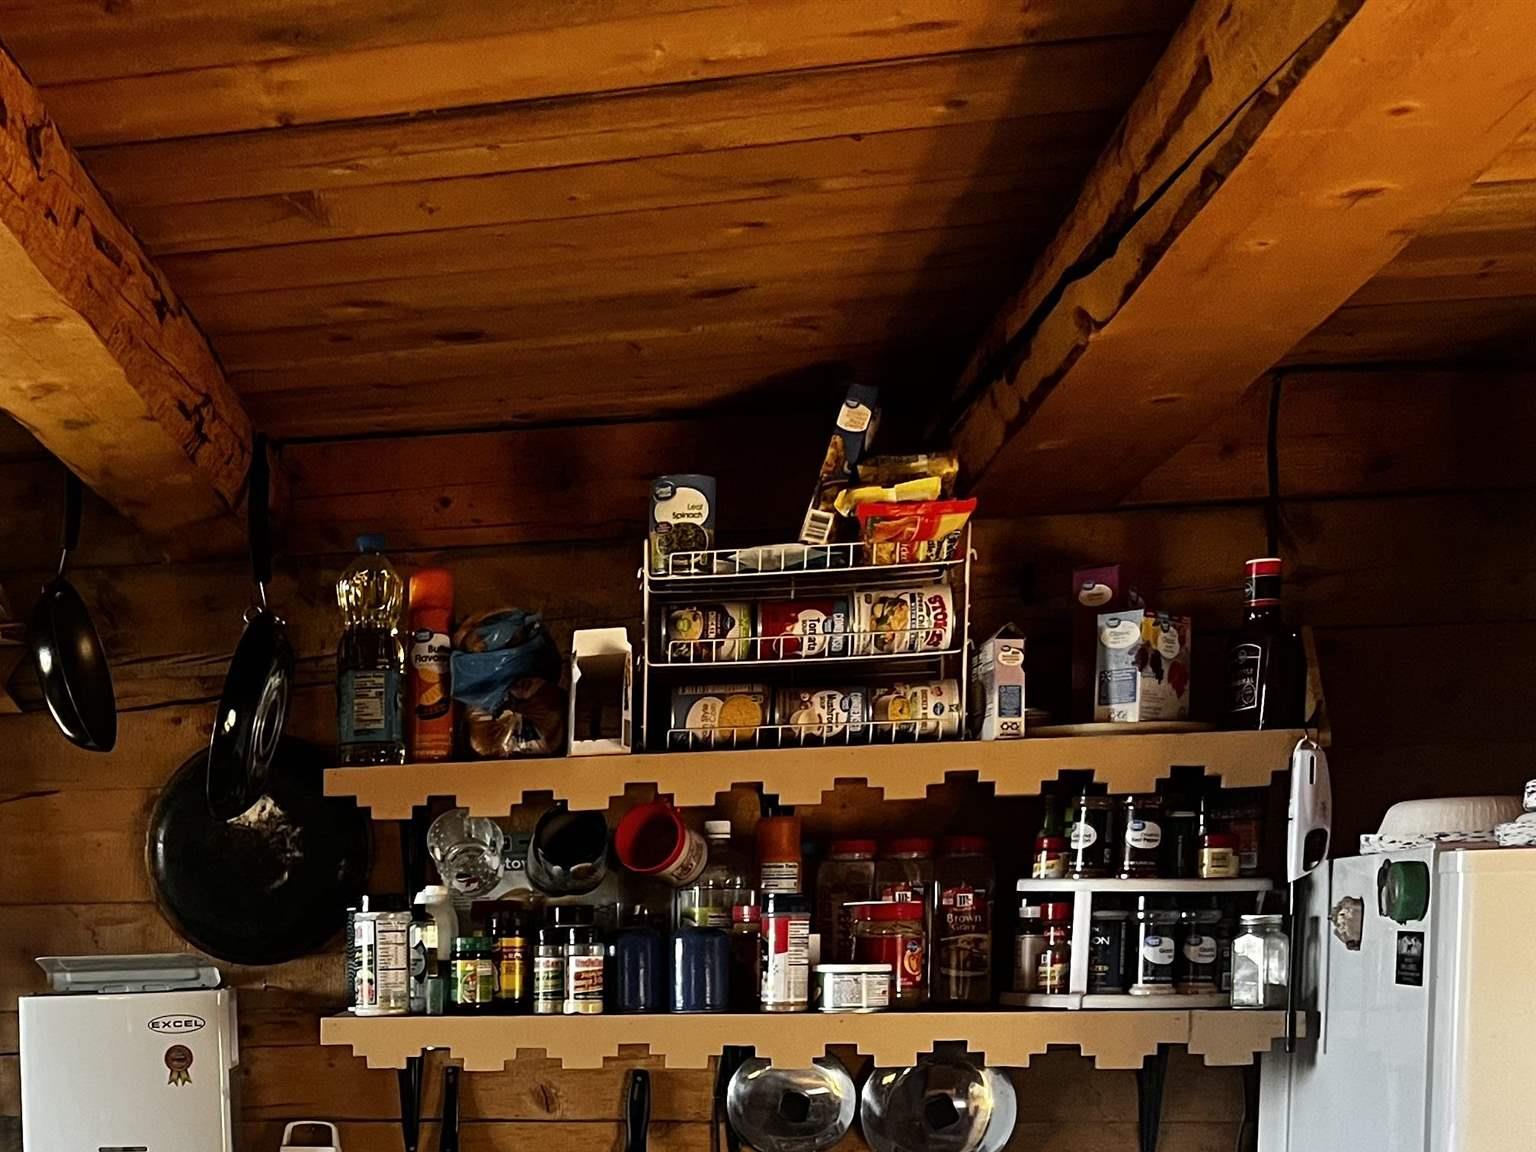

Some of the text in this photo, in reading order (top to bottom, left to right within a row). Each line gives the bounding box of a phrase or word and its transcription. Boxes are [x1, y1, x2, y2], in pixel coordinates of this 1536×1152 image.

[672, 512, 703, 520] Spinach
[826, 693, 837, 733] Mushroom
[946, 912, 983, 924] Brown
[151, 1019, 203, 1029] EXCEL
